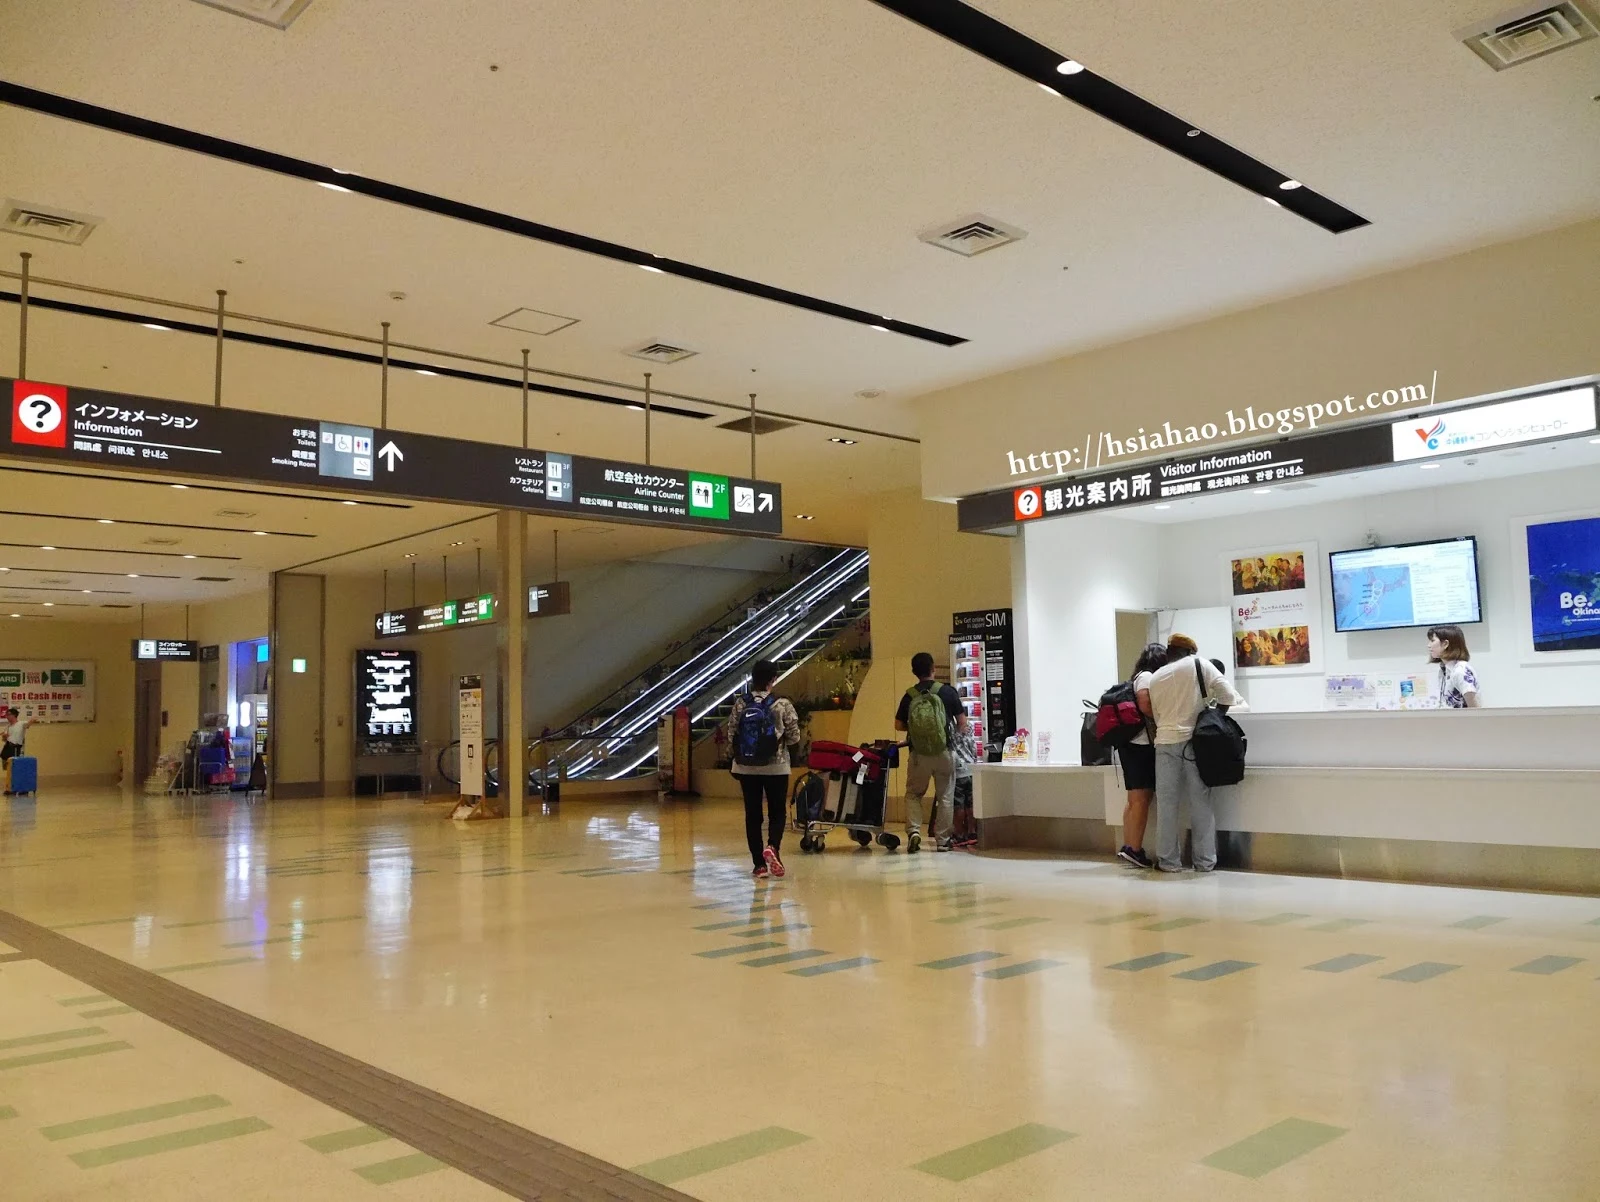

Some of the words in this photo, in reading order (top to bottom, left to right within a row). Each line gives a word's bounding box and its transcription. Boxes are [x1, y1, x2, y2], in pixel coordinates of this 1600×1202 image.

[75, 403, 198, 429] インフォメーション
[74, 420, 142, 437] Information
[142, 448, 168, 460] 안내소
[272, 457, 298, 468] Smoking
[515, 457, 544, 468] レストラン
[1160, 462, 1197, 478] Visitor
[1200, 450, 1272, 471] Information
[519, 466, 544, 474] Restaurant
[1256, 470, 1274, 482] 관광
[1275, 465, 1304, 478] 안내소
[510, 476, 544, 487] カフェテリア
[604, 469, 684, 488] 航空会社カウンター
[635, 488, 657, 497] Airline
[658, 490, 685, 500] Counter
[715, 484, 726, 493] 2F
[1044, 472, 1152, 512] 観光案内所
[1560, 592, 1592, 608] Be.
[985, 612, 1006, 627] SIM
[12, 692, 26, 700] Get
[28, 692, 50, 700] Cash
